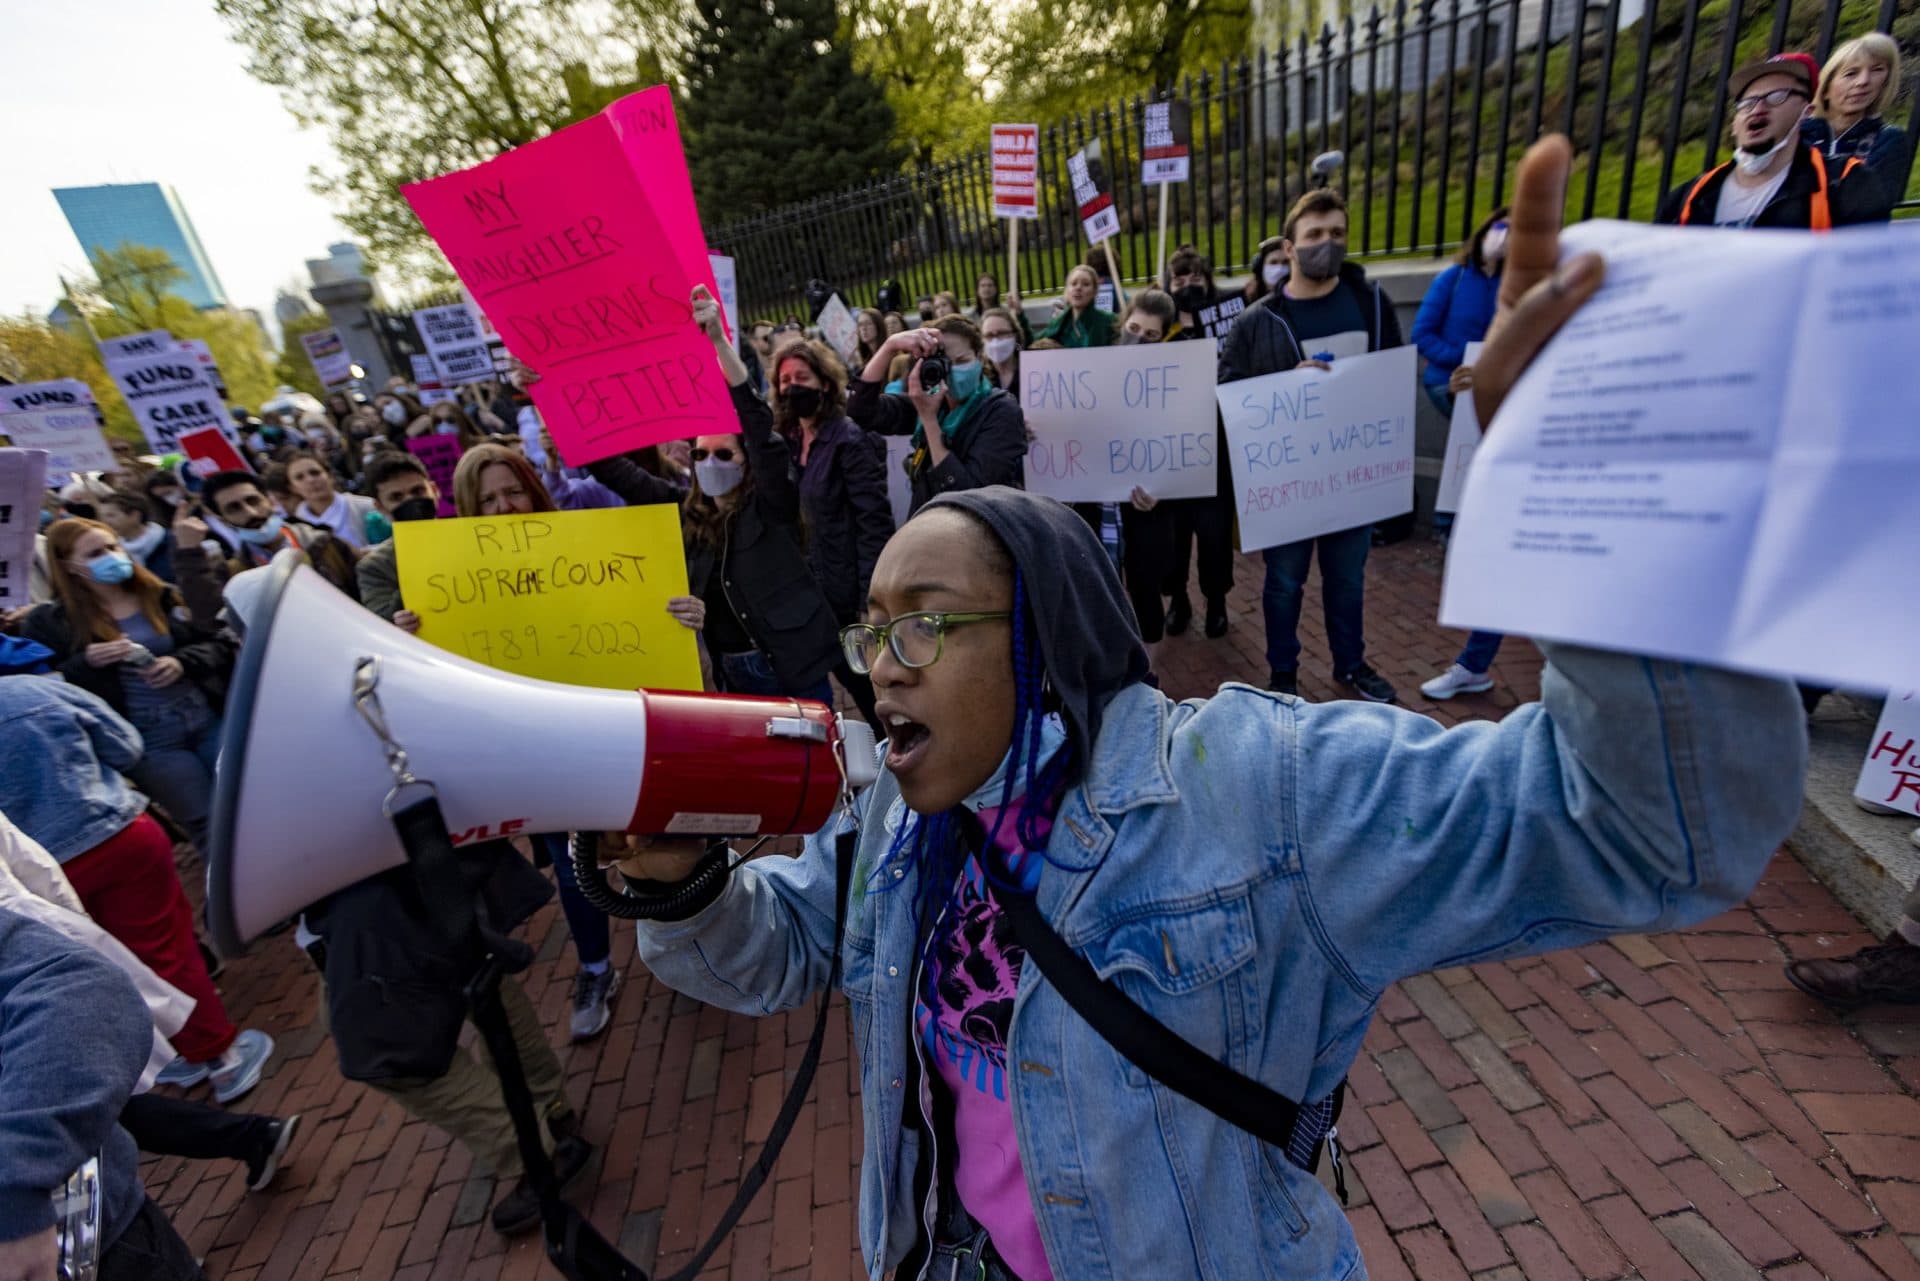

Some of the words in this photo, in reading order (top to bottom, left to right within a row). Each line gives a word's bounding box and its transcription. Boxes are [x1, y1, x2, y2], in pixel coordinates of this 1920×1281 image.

[463, 180, 519, 225] MY
[452, 215, 625, 288] DAUGHTER
[506, 274, 694, 356] DESERVES
[123, 364, 195, 390] FUND
[561, 353, 721, 430] BETTER
[1028, 370, 1097, 410] BANS
[1124, 365, 1179, 410] OFF
[11, 390, 77, 410] FUND
[148, 401, 211, 422] CARE
[1242, 382, 1325, 430] SAVE
[1030, 439, 1088, 480] OUR
[1109, 432, 1214, 475] BODIES
[1243, 434, 1301, 473] ROE
[1244, 477, 1325, 516] ABORTION
[1329, 473, 1343, 493] IS
[474, 519, 552, 555] RIP
[427, 567, 547, 613] SUPREME
[551, 551, 647, 588] COURT
